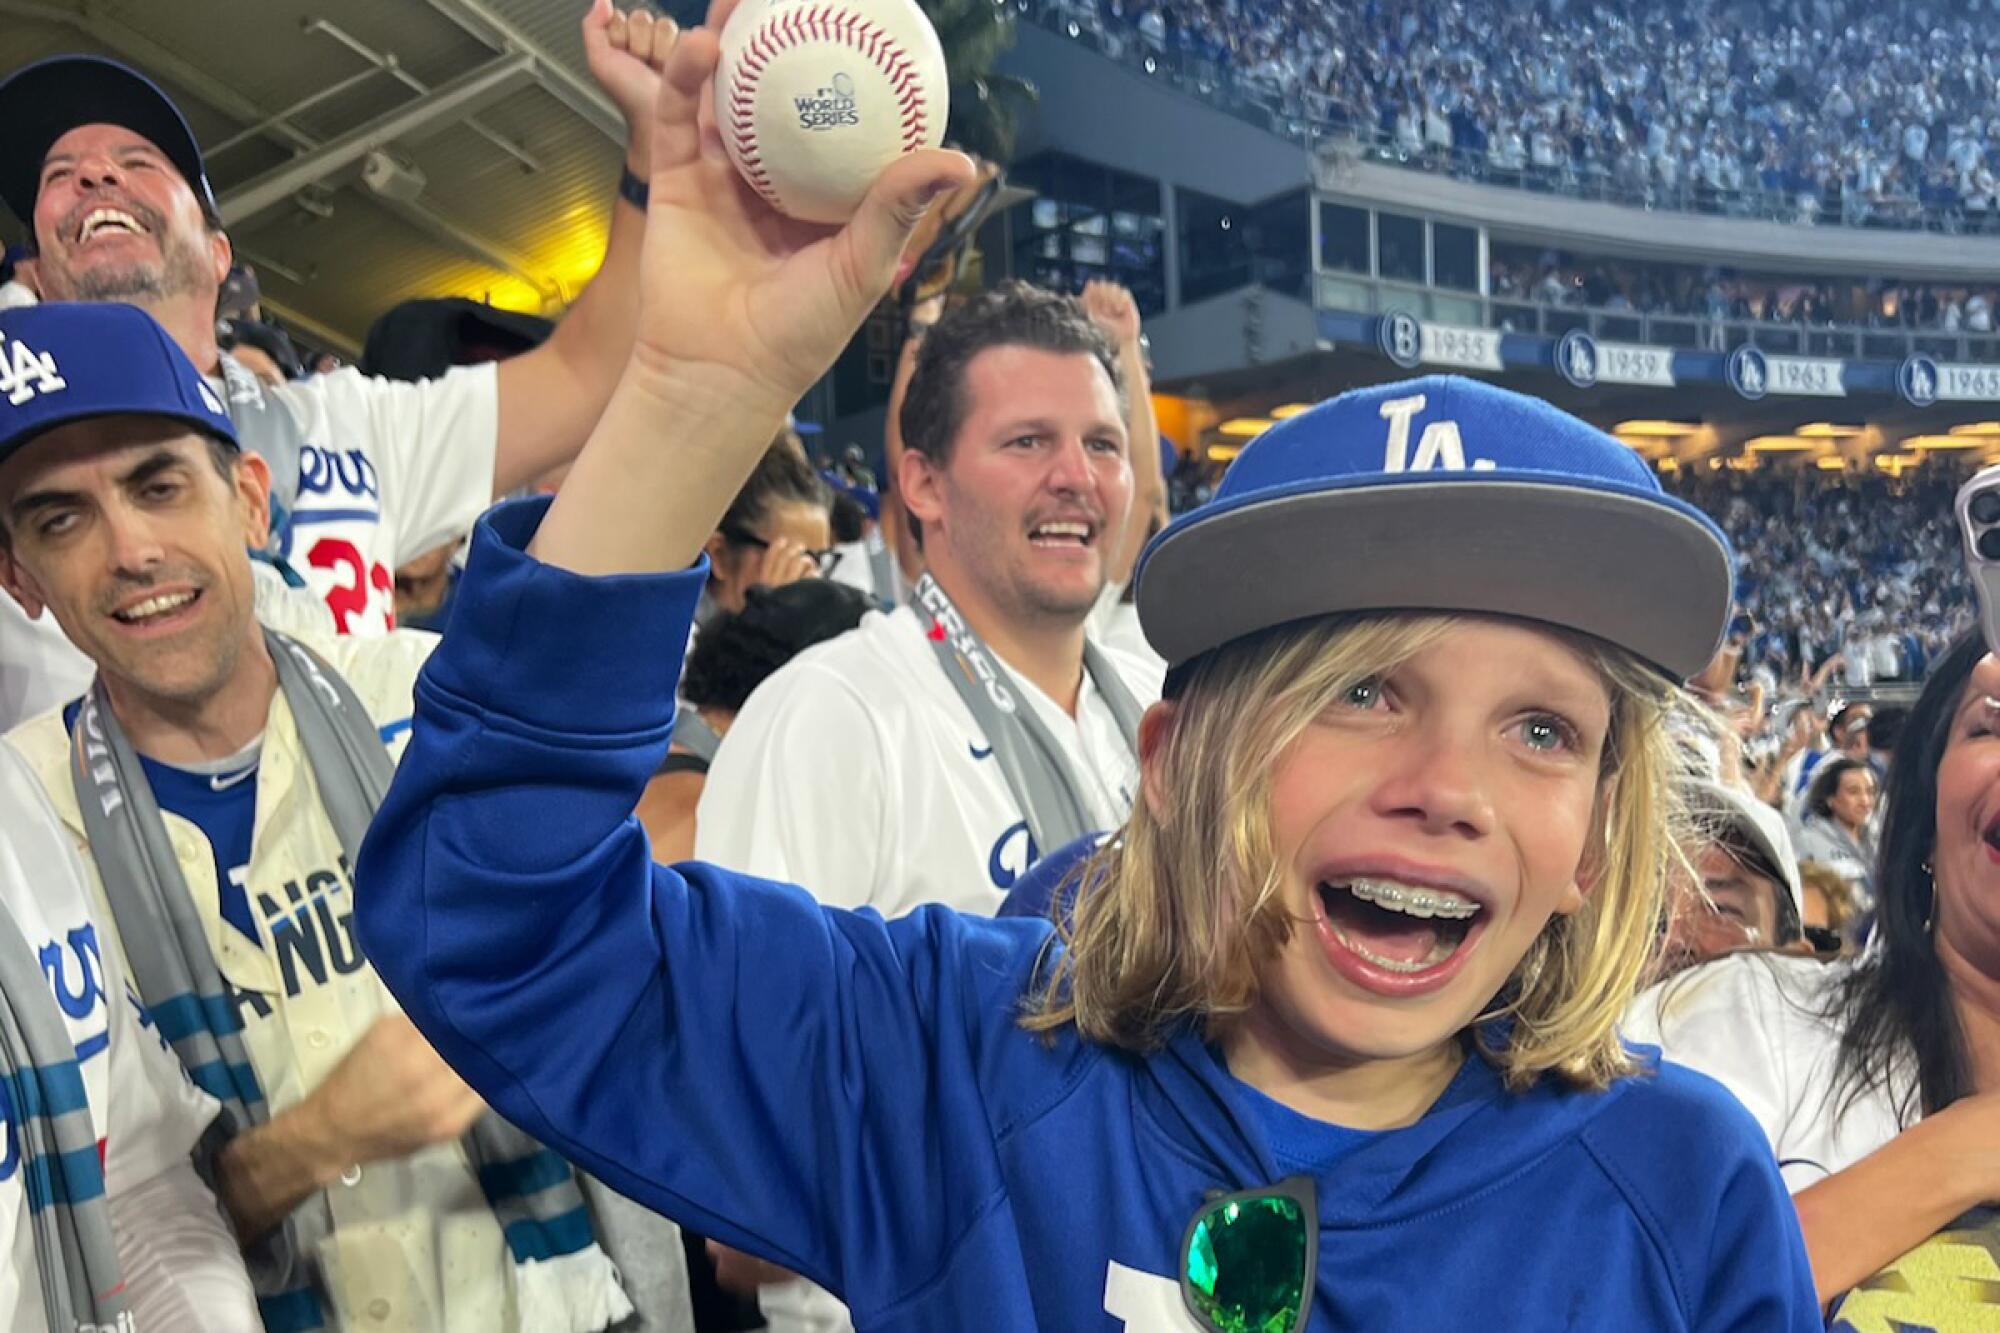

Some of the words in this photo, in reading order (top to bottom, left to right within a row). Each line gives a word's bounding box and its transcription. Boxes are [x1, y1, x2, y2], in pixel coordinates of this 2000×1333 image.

[794, 97, 855, 112] WORLD
[799, 110, 859, 128] SERIES
[1432, 329, 1486, 360] 1955
[1607, 350, 1657, 377] 1959
[1779, 362, 1827, 389] 1963
[1950, 369, 1999, 396] 1965
